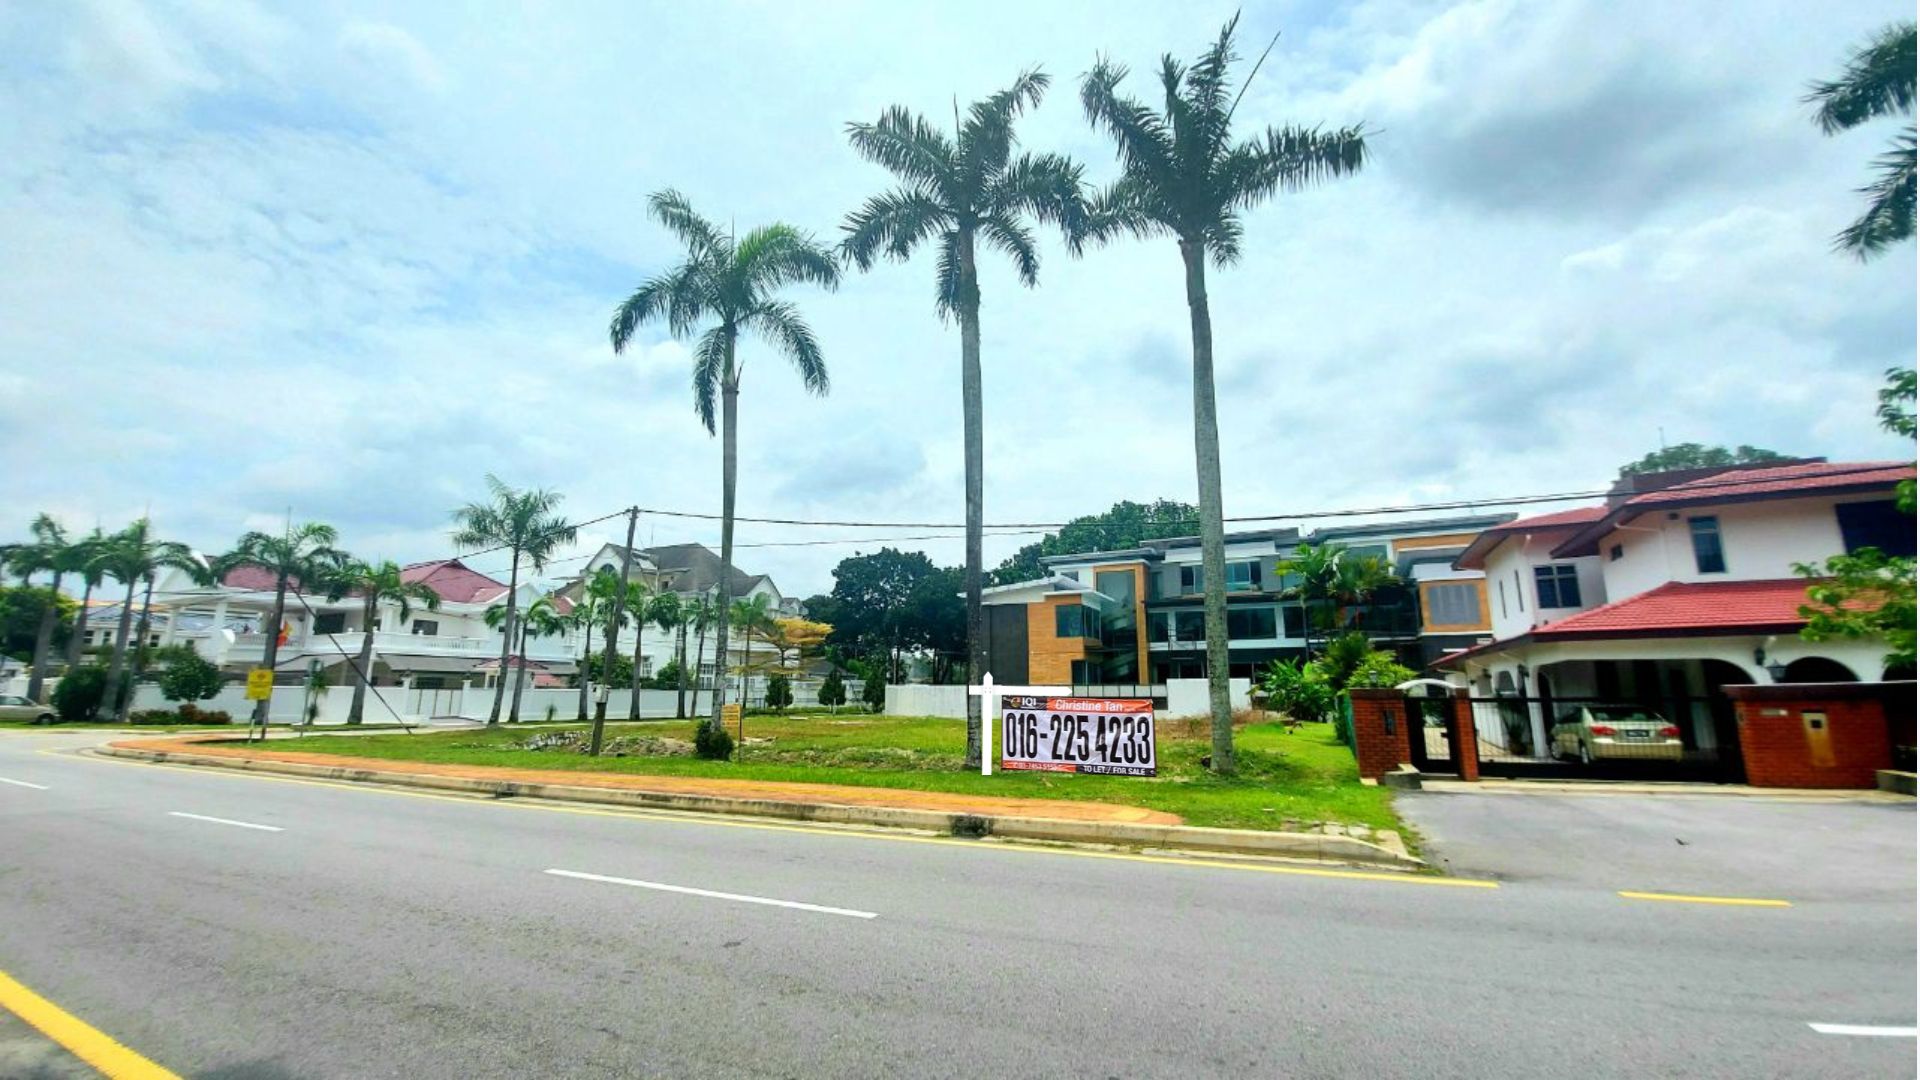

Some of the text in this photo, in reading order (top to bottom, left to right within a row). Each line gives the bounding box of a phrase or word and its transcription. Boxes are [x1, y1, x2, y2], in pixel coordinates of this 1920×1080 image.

[1022, 697, 1036, 706] IQI
[1055, 699, 1123, 712] Christine Tan
[1006, 712, 1151, 764] 016-225 4233
[1083, 765, 1092, 773] TO
[1093, 765, 1105, 773] LET
[1128, 768, 1146, 776] SALE
